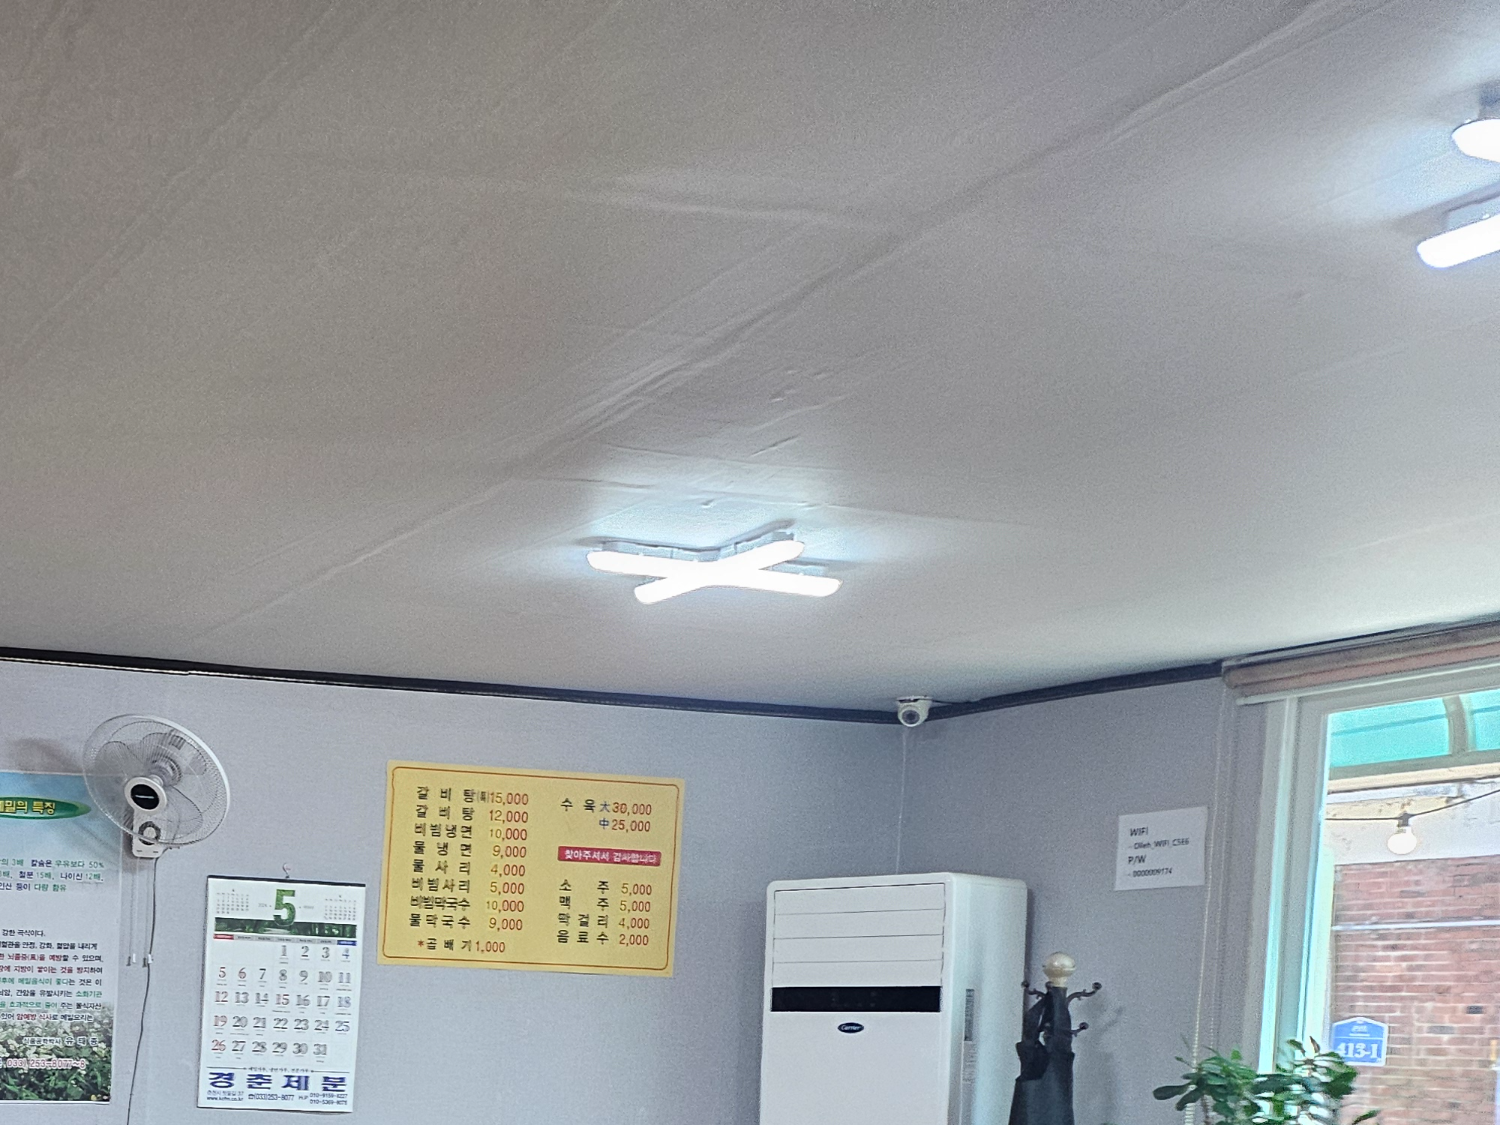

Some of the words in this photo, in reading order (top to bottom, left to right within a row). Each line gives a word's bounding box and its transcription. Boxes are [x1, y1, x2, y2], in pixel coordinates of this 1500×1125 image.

[489, 792, 529, 806] 15,000
[32, 801, 56, 815] 특징
[612, 801, 652, 816] 30,000
[489, 810, 529, 823] 12,000
[611, 819, 651, 833] 25,000
[489, 828, 528, 841] 10,000
[492, 845, 527, 859] 9,000
[55, 860, 85, 869] 우유보다
[490, 864, 526, 877] 4,000
[489, 881, 525, 895] 5,000
[620, 883, 652, 896] 5,000
[273, 889, 296, 926] 5
[486, 899, 525, 913] 10,000
[619, 900, 651, 913] 5,000
[488, 917, 524, 931] 9,000
[618, 917, 650, 930] 4,000
[618, 933, 649, 946] 2,000
[281, 945, 287, 957] 1
[301, 946, 309, 957] 2
[321, 947, 330, 958] 3
[342, 948, 350, 959] 4
[475, 941, 506, 953] 1,000
[218, 966, 226, 978] 5
[238, 967, 246, 979] 6
[259, 968, 266, 979] 7
[279, 969, 287, 981] 8
[299, 970, 308, 982] 9
[318, 971, 332, 983] 10
[338, 972, 351, 983] 11
[215, 991, 228, 1002] 12
[235, 992, 249, 1004] 13
[255, 992, 269, 1004] 14
[275, 994, 290, 1006] 15
[296, 994, 310, 1006] 16
[317, 995, 330, 1007] 17
[337, 996, 351, 1008] 18
[213, 1015, 227, 1027] 19
[232, 1016, 248, 1028] 20
[253, 1017, 266, 1028] 21
[273, 1018, 288, 1029] 22
[294, 1019, 309, 1030] 23
[314, 1019, 329, 1031] 24
[335, 1020, 350, 1031] 25
[211, 1039, 226, 1051] 26
[232, 1040, 246, 1052] 27
[252, 1041, 267, 1053] 28
[272, 1042, 288, 1053] 29
[292, 1042, 308, 1054] 30
[313, 1043, 327, 1055] 31
[1336, 1042, 1379, 1059] 413-1
